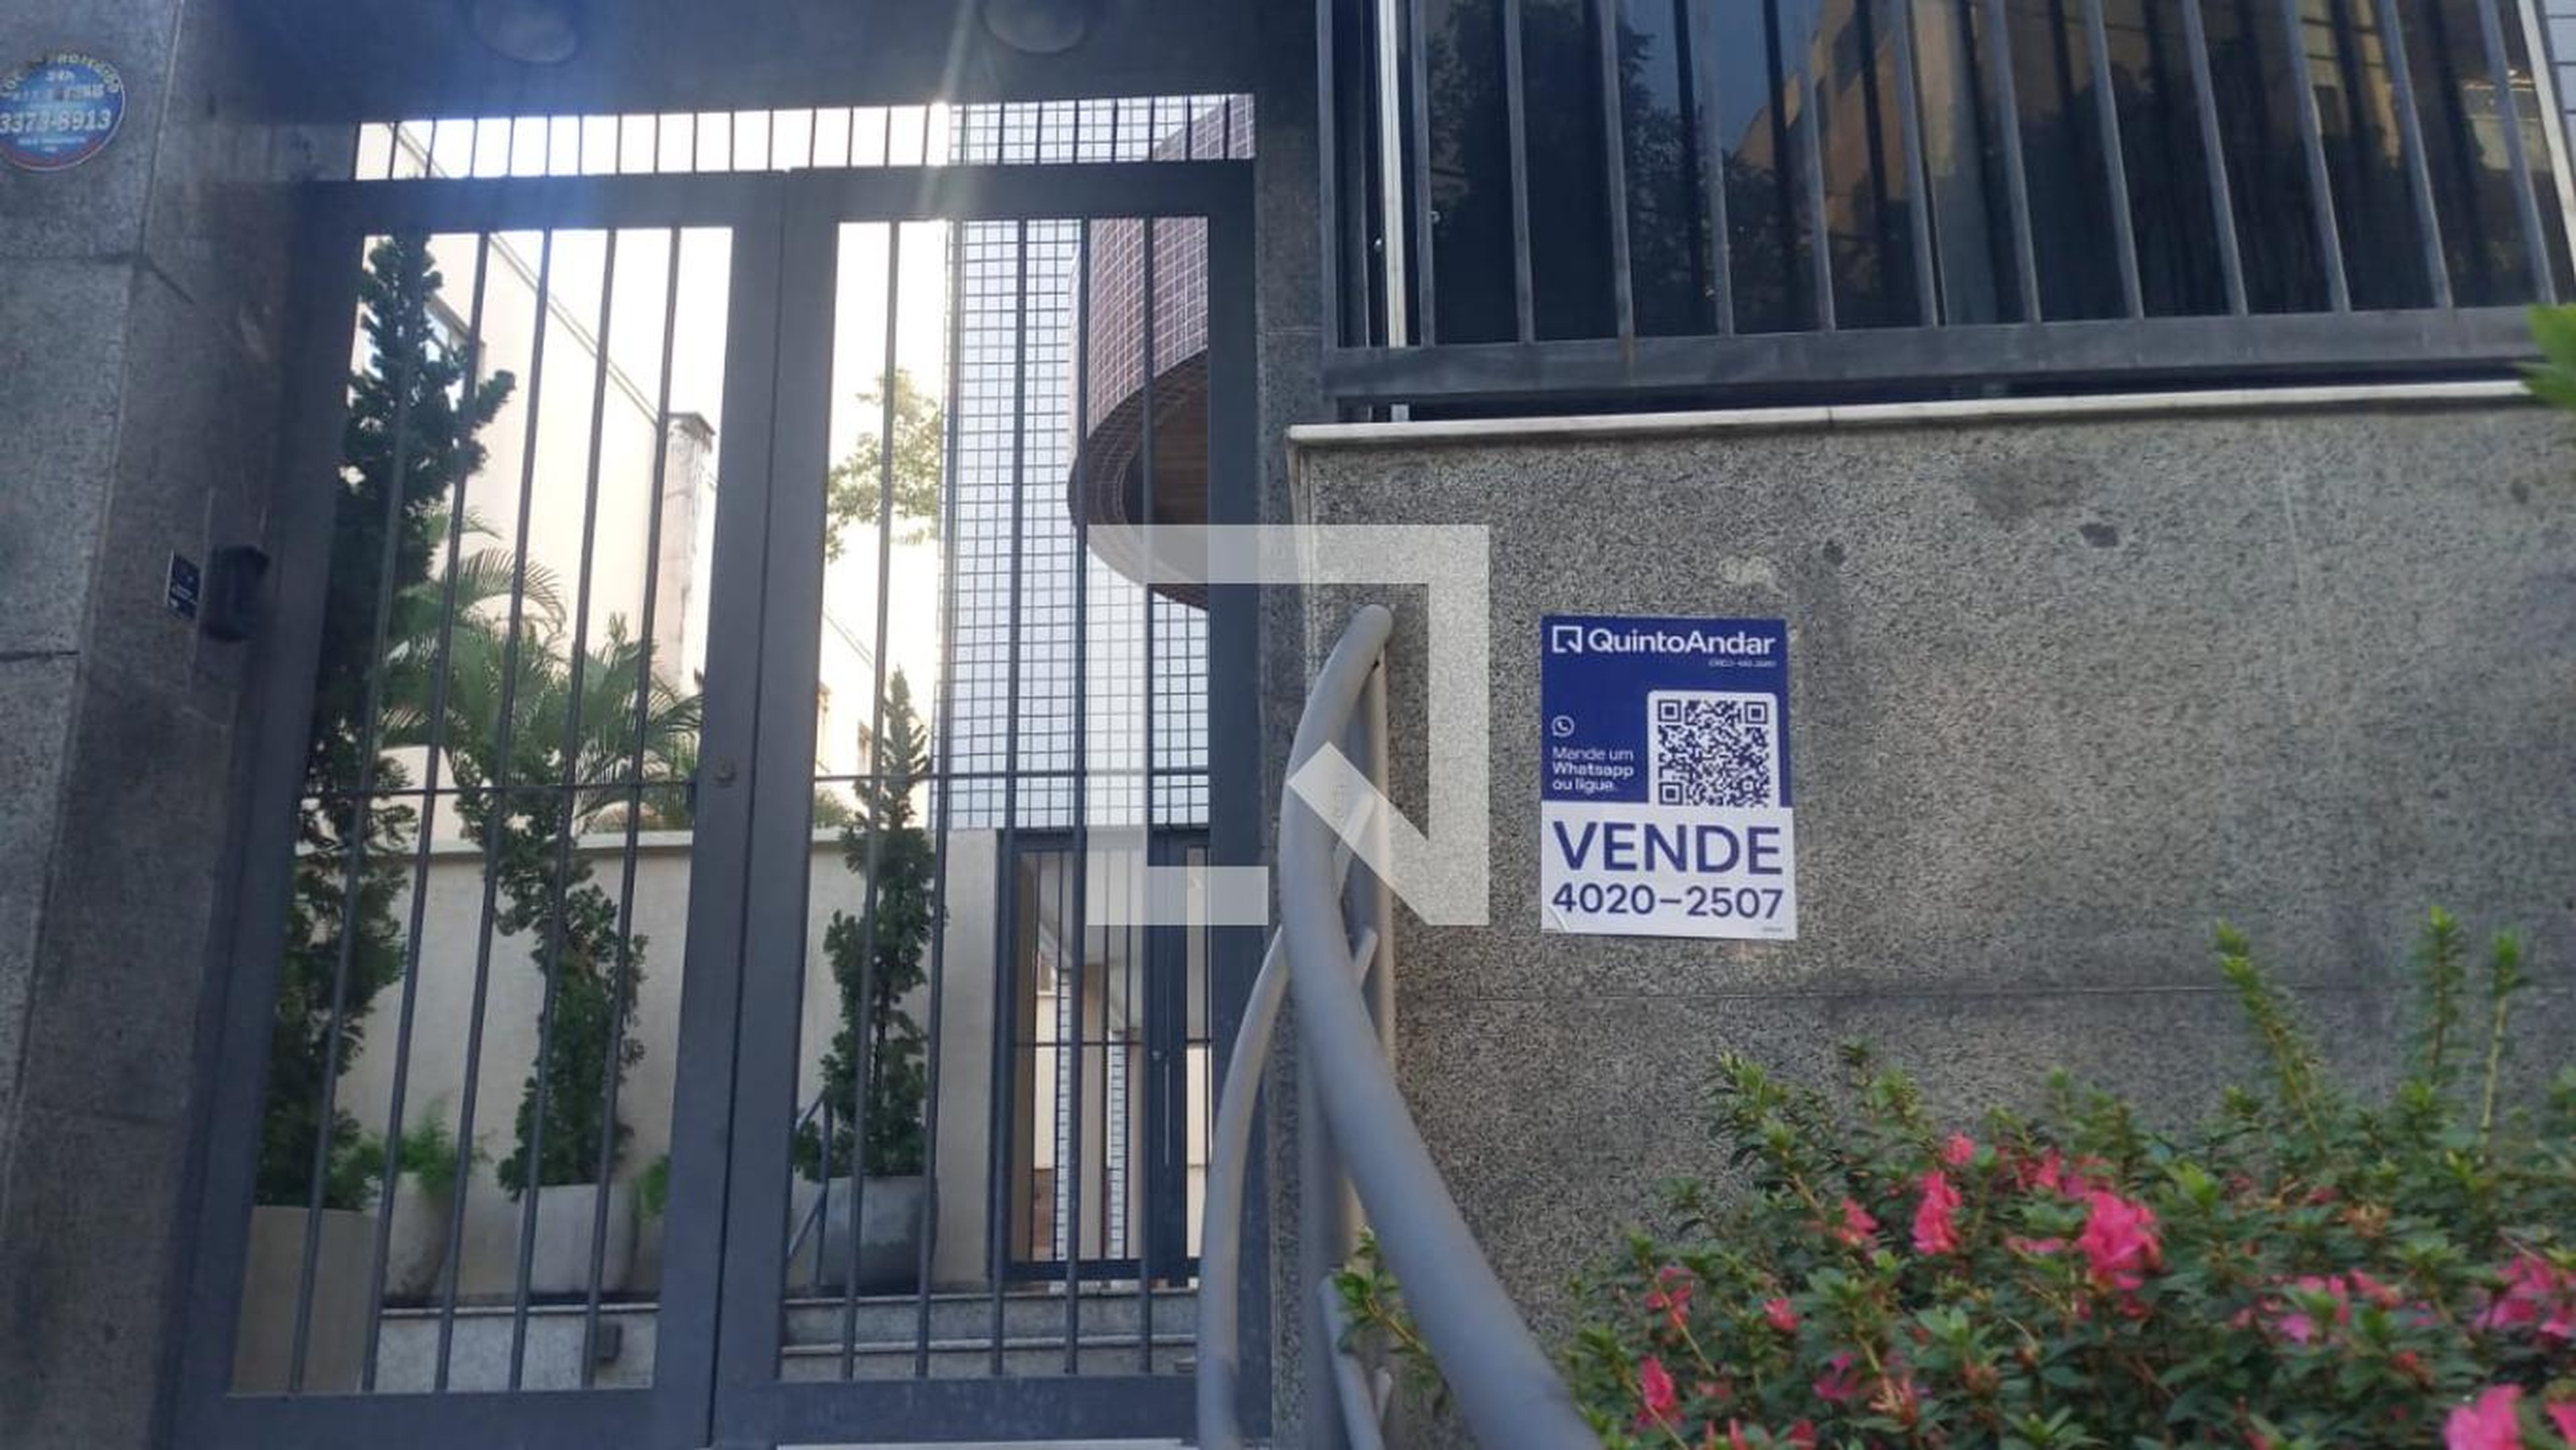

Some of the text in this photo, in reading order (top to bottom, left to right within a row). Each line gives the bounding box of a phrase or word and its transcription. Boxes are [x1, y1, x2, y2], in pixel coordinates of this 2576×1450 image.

[1587, 628, 1776, 655] QuintoAndar
[1552, 746, 1633, 761] Mande um
[1552, 762, 1634, 780] Whatsapp
[1552, 780, 1572, 790] ou
[1552, 821, 1782, 874] VENDE
[1552, 882, 1783, 919] 4020-2507
